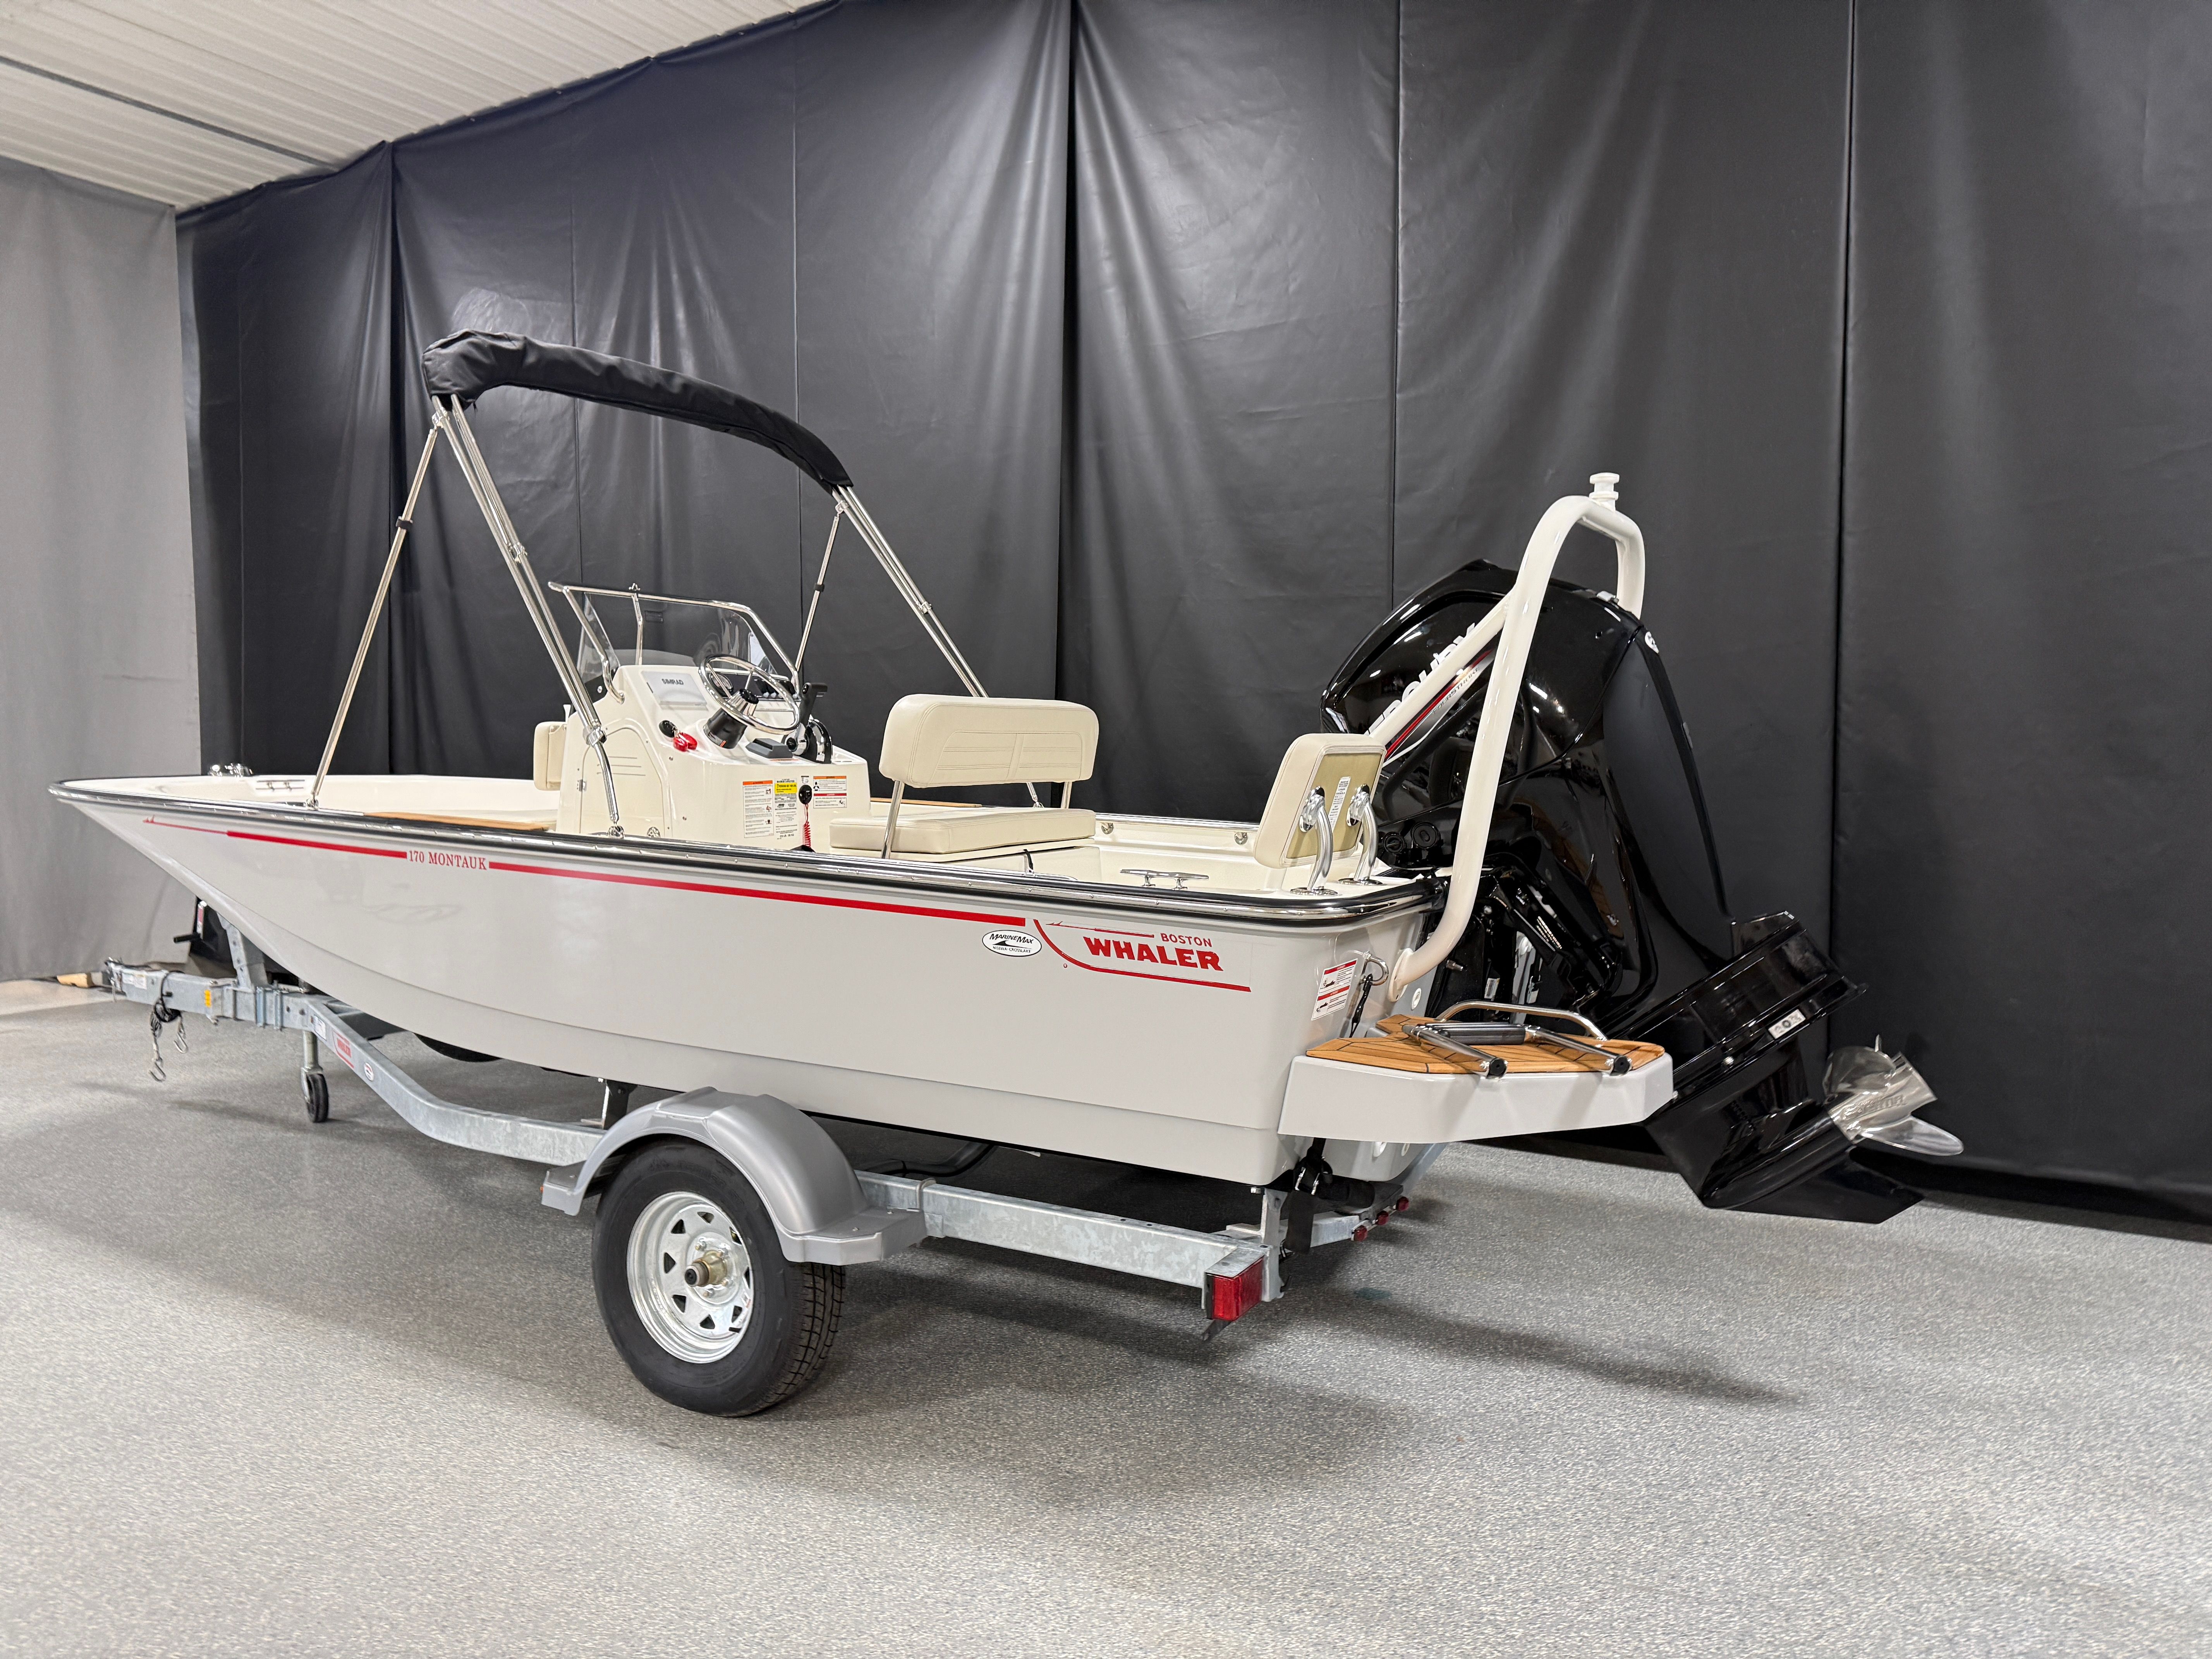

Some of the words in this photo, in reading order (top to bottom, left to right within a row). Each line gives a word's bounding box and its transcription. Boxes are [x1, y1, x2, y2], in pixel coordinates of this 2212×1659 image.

[409, 850, 424, 863] 170
[428, 852, 487, 870] MONTAUK
[1161, 933, 1212, 948] BOSTON
[1083, 936, 1224, 971] WHALER
